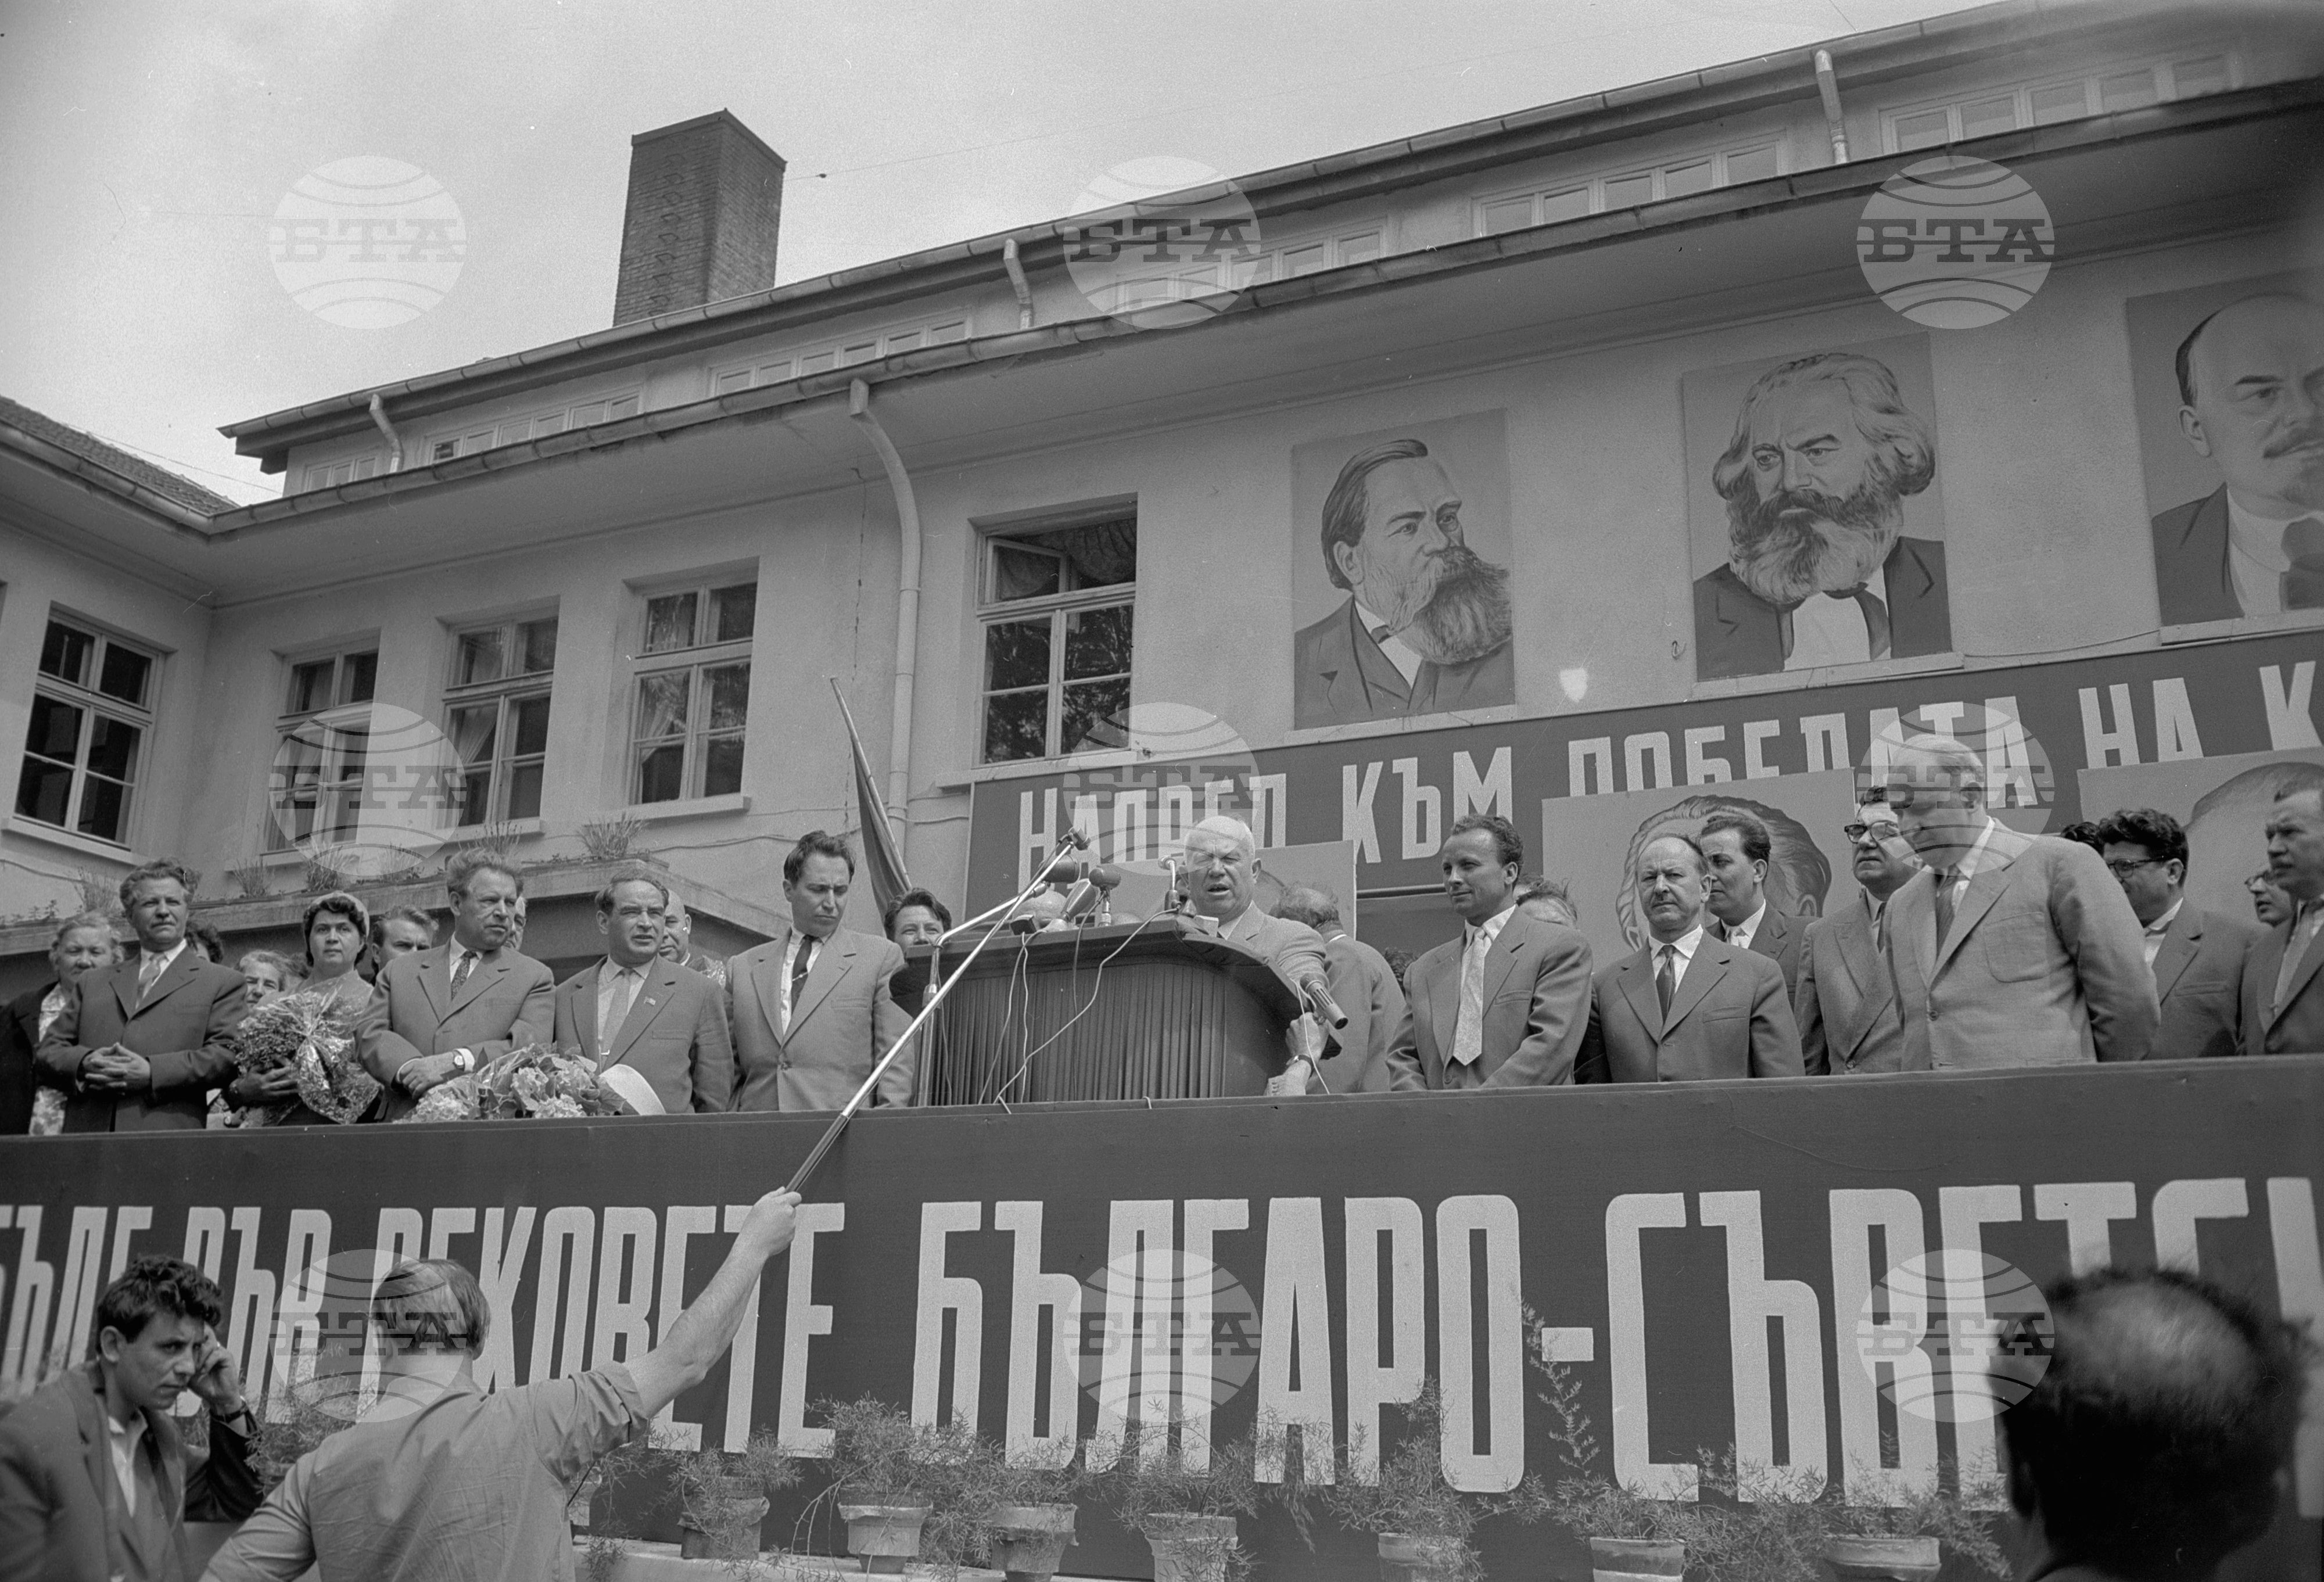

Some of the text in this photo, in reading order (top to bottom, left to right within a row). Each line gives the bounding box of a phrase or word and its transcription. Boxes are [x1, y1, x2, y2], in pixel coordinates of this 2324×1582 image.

[1342, 746, 1512, 864] КЪМ
[2078, 677, 2204, 770] НА
[2259, 661, 2324, 752] К
